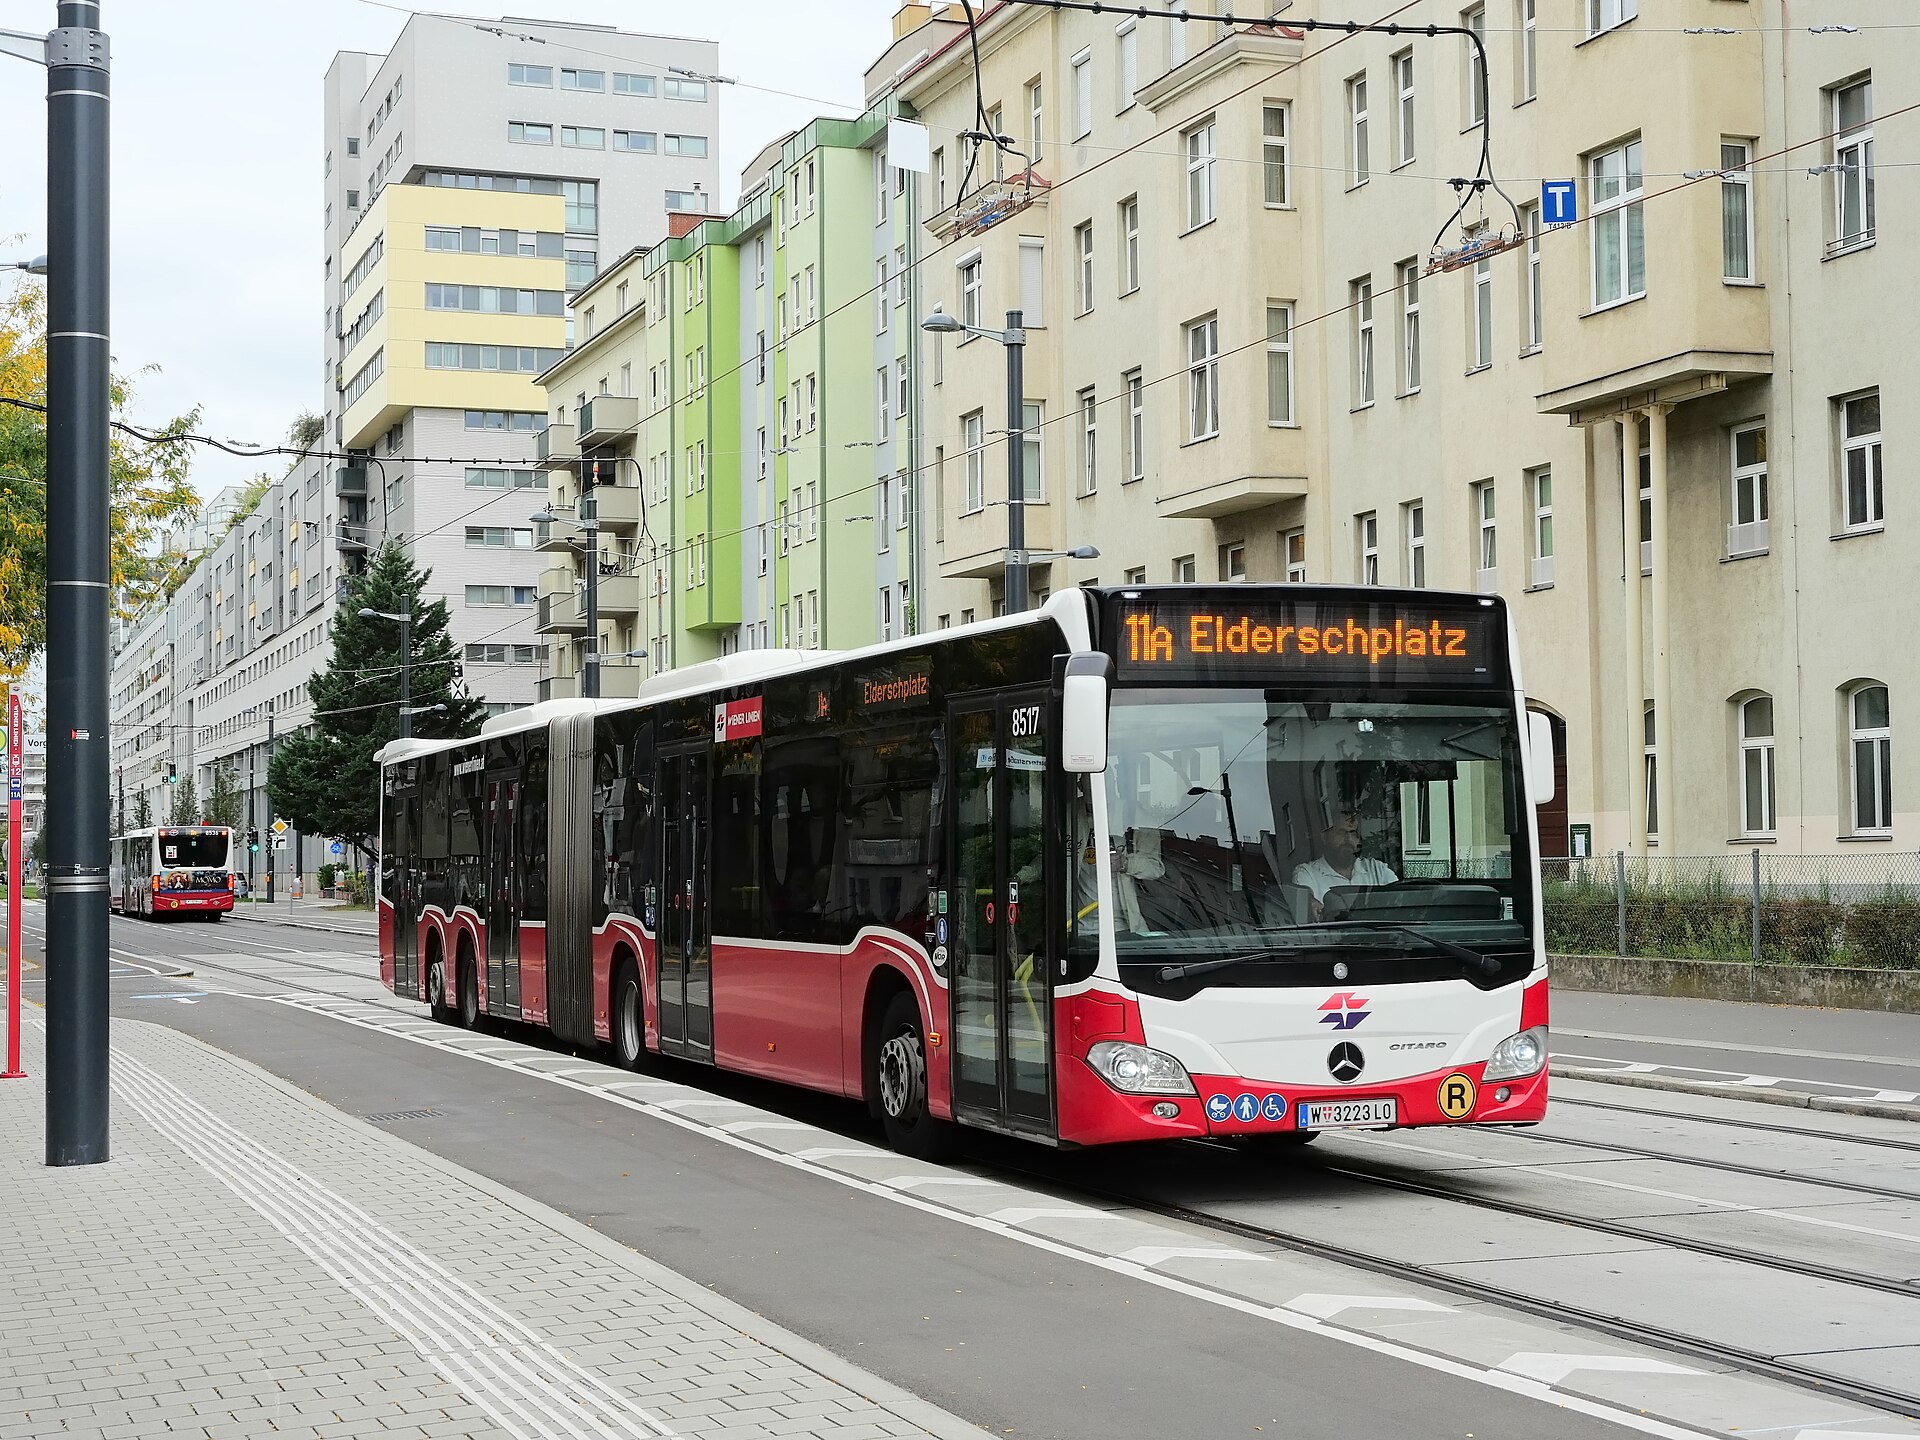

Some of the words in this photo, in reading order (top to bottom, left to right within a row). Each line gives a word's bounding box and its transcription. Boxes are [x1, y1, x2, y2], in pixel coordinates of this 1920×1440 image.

[1547, 186, 1570, 218] T
[1126, 614, 1172, 662] 11A
[1190, 615, 1467, 664] Elderschplatz
[864, 672, 927, 704] Elderschplatz
[727, 712, 746, 727] WIENER
[745, 709, 761, 724] LINIEN
[1012, 706, 1040, 736] 8517
[11, 768, 21, 776] 12
[1389, 1042, 1447, 1050] CITARO
[1447, 1083, 1466, 1109] R
[1311, 1106, 1322, 1123] W
[1333, 1104, 1371, 1122] 3223
